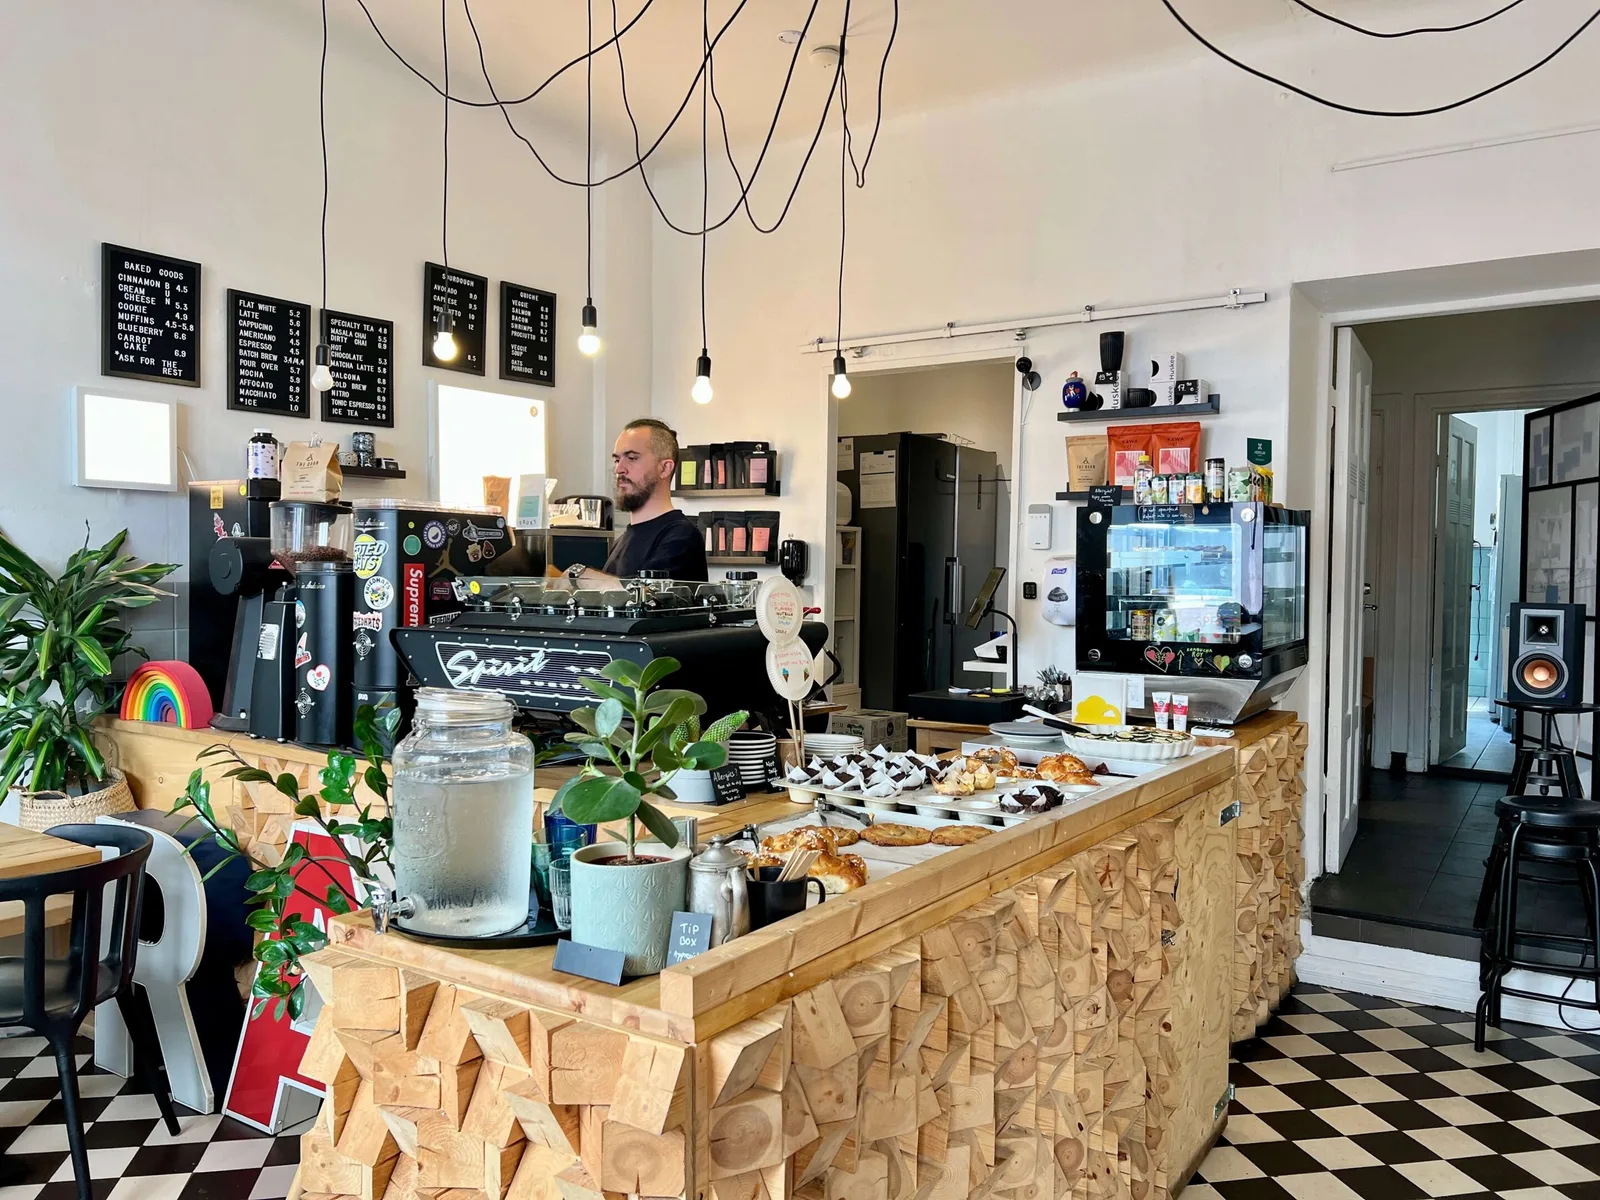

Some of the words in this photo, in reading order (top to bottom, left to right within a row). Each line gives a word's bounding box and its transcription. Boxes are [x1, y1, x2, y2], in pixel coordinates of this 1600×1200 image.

[125, 261, 151, 273] BAKED
[159, 269, 183, 280] GOODS
[118, 274, 160, 288] CINNAMON
[176, 285, 188, 293] 4.5
[118, 284, 145, 295] CREAM
[124, 293, 156, 305] CHEESE
[175, 302, 188, 311] 5.3
[433, 295, 457, 305] CAPESE
[118, 302, 147, 314] COOKIE
[239, 300, 254, 308] FLAT
[258, 303, 276, 313] WHITE
[512, 307, 531, 316] SALMON
[239, 310, 259, 319] LATTE
[512, 315, 528, 323] BACON
[118, 312, 154, 325] MUFFINS
[165, 320, 194, 331] 4.5-5.8
[239, 320, 272, 331] CAPPUCINO
[331, 319, 360, 330] SPECIALTY
[118, 322, 163, 336] BLUEBERRY
[331, 328, 353, 337] MASALA
[118, 333, 152, 345] CARROT
[239, 329, 276, 342] AMERICANO
[331, 335, 347, 343] DIRTY
[124, 342, 147, 352] CAKE
[239, 339, 272, 350] ESPRESSO
[239, 349, 258, 358] BATCH
[261, 352, 277, 361] BREW
[331, 351, 363, 361] CHOCOLATE
[140, 357, 155, 365] FOR
[162, 360, 177, 368] THE
[240, 359, 256, 367] POUR
[261, 362, 278, 371] OVER
[331, 360, 353, 369] MATCHA
[357, 364, 374, 372] LATTE
[163, 368, 183, 376] REST
[240, 369, 263, 378] MOCHA
[240, 388, 276, 399] MACCHIATO
[349, 401, 375, 410] ESPRESSO
[406, 568, 423, 627] Suprem
[447, 650, 550, 686] Spirit
[680, 922, 699, 934] Tip
[680, 936, 697, 947] Box
